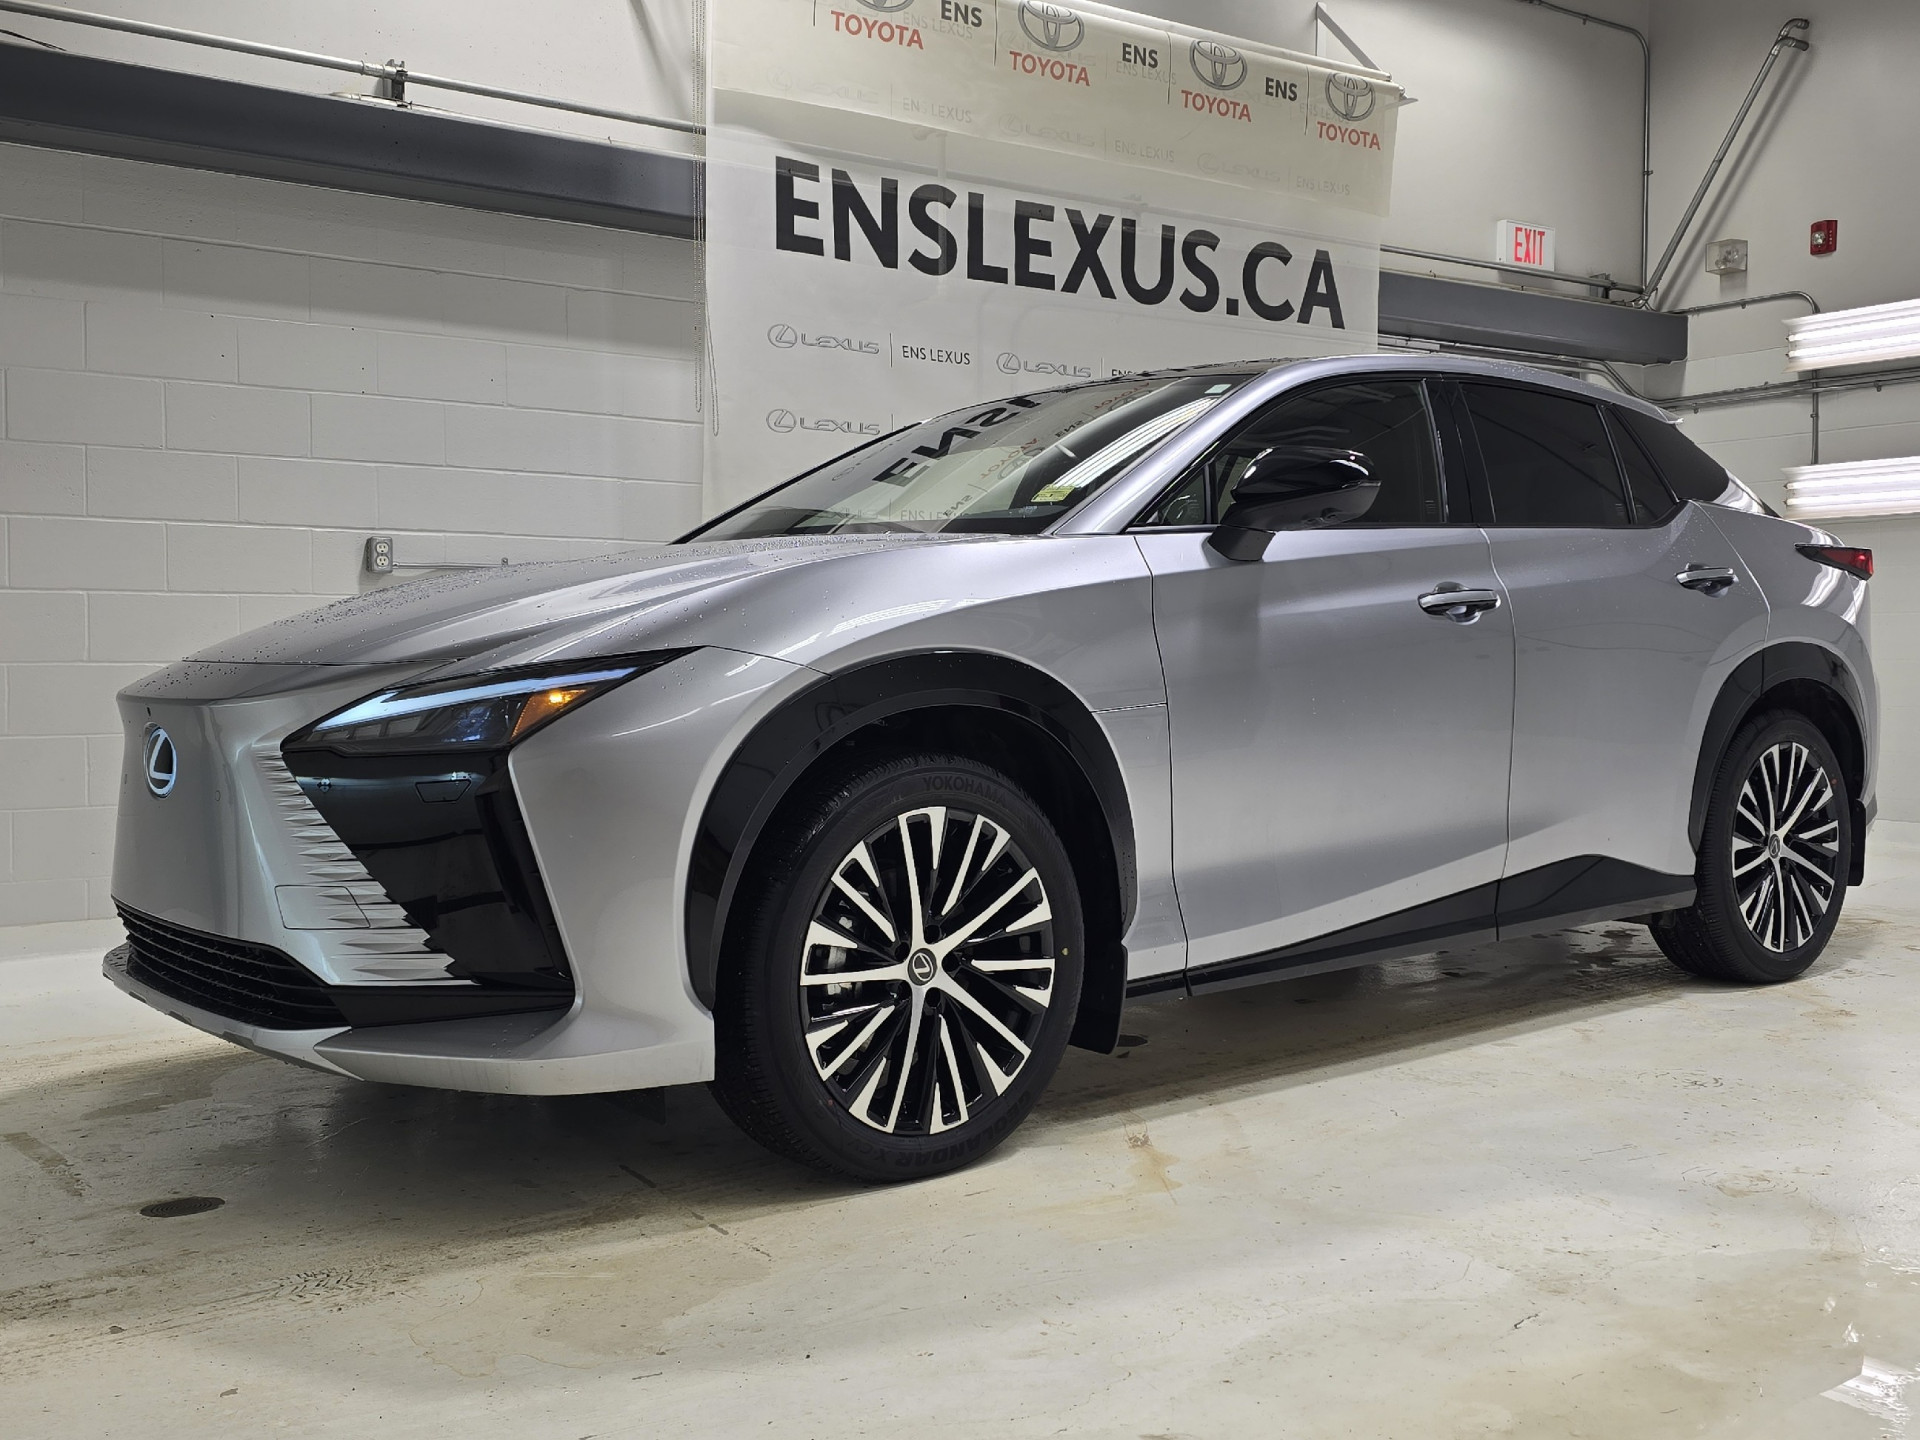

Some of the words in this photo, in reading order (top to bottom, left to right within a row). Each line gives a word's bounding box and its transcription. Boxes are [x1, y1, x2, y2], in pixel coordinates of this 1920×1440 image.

[940, 0, 983, 28] ENS
[831, 10, 924, 50] TOYOTA
[1009, 51, 1091, 87] TOYOTA
[1122, 42, 1159, 69] ENS
[1265, 76, 1298, 102] ENS
[931, 102, 972, 124] LEXUS
[1181, 89, 1252, 122] TOYOTA
[1316, 121, 1381, 151] TOYOTA
[775, 155, 1346, 330] ENSLEXUS.CA
[1514, 226, 1546, 266] EXIT
[801, 332, 880, 355] LEXUS
[902, 345, 927, 361] ENS
[930, 349, 971, 366] LEXUS
[1023, 360, 1092, 379] LEXUS
[800, 417, 881, 436] LEXUS
[922, 775, 1007, 806] YOKOHAMA
[895, 1089, 1033, 1168] GEOLANDAR
